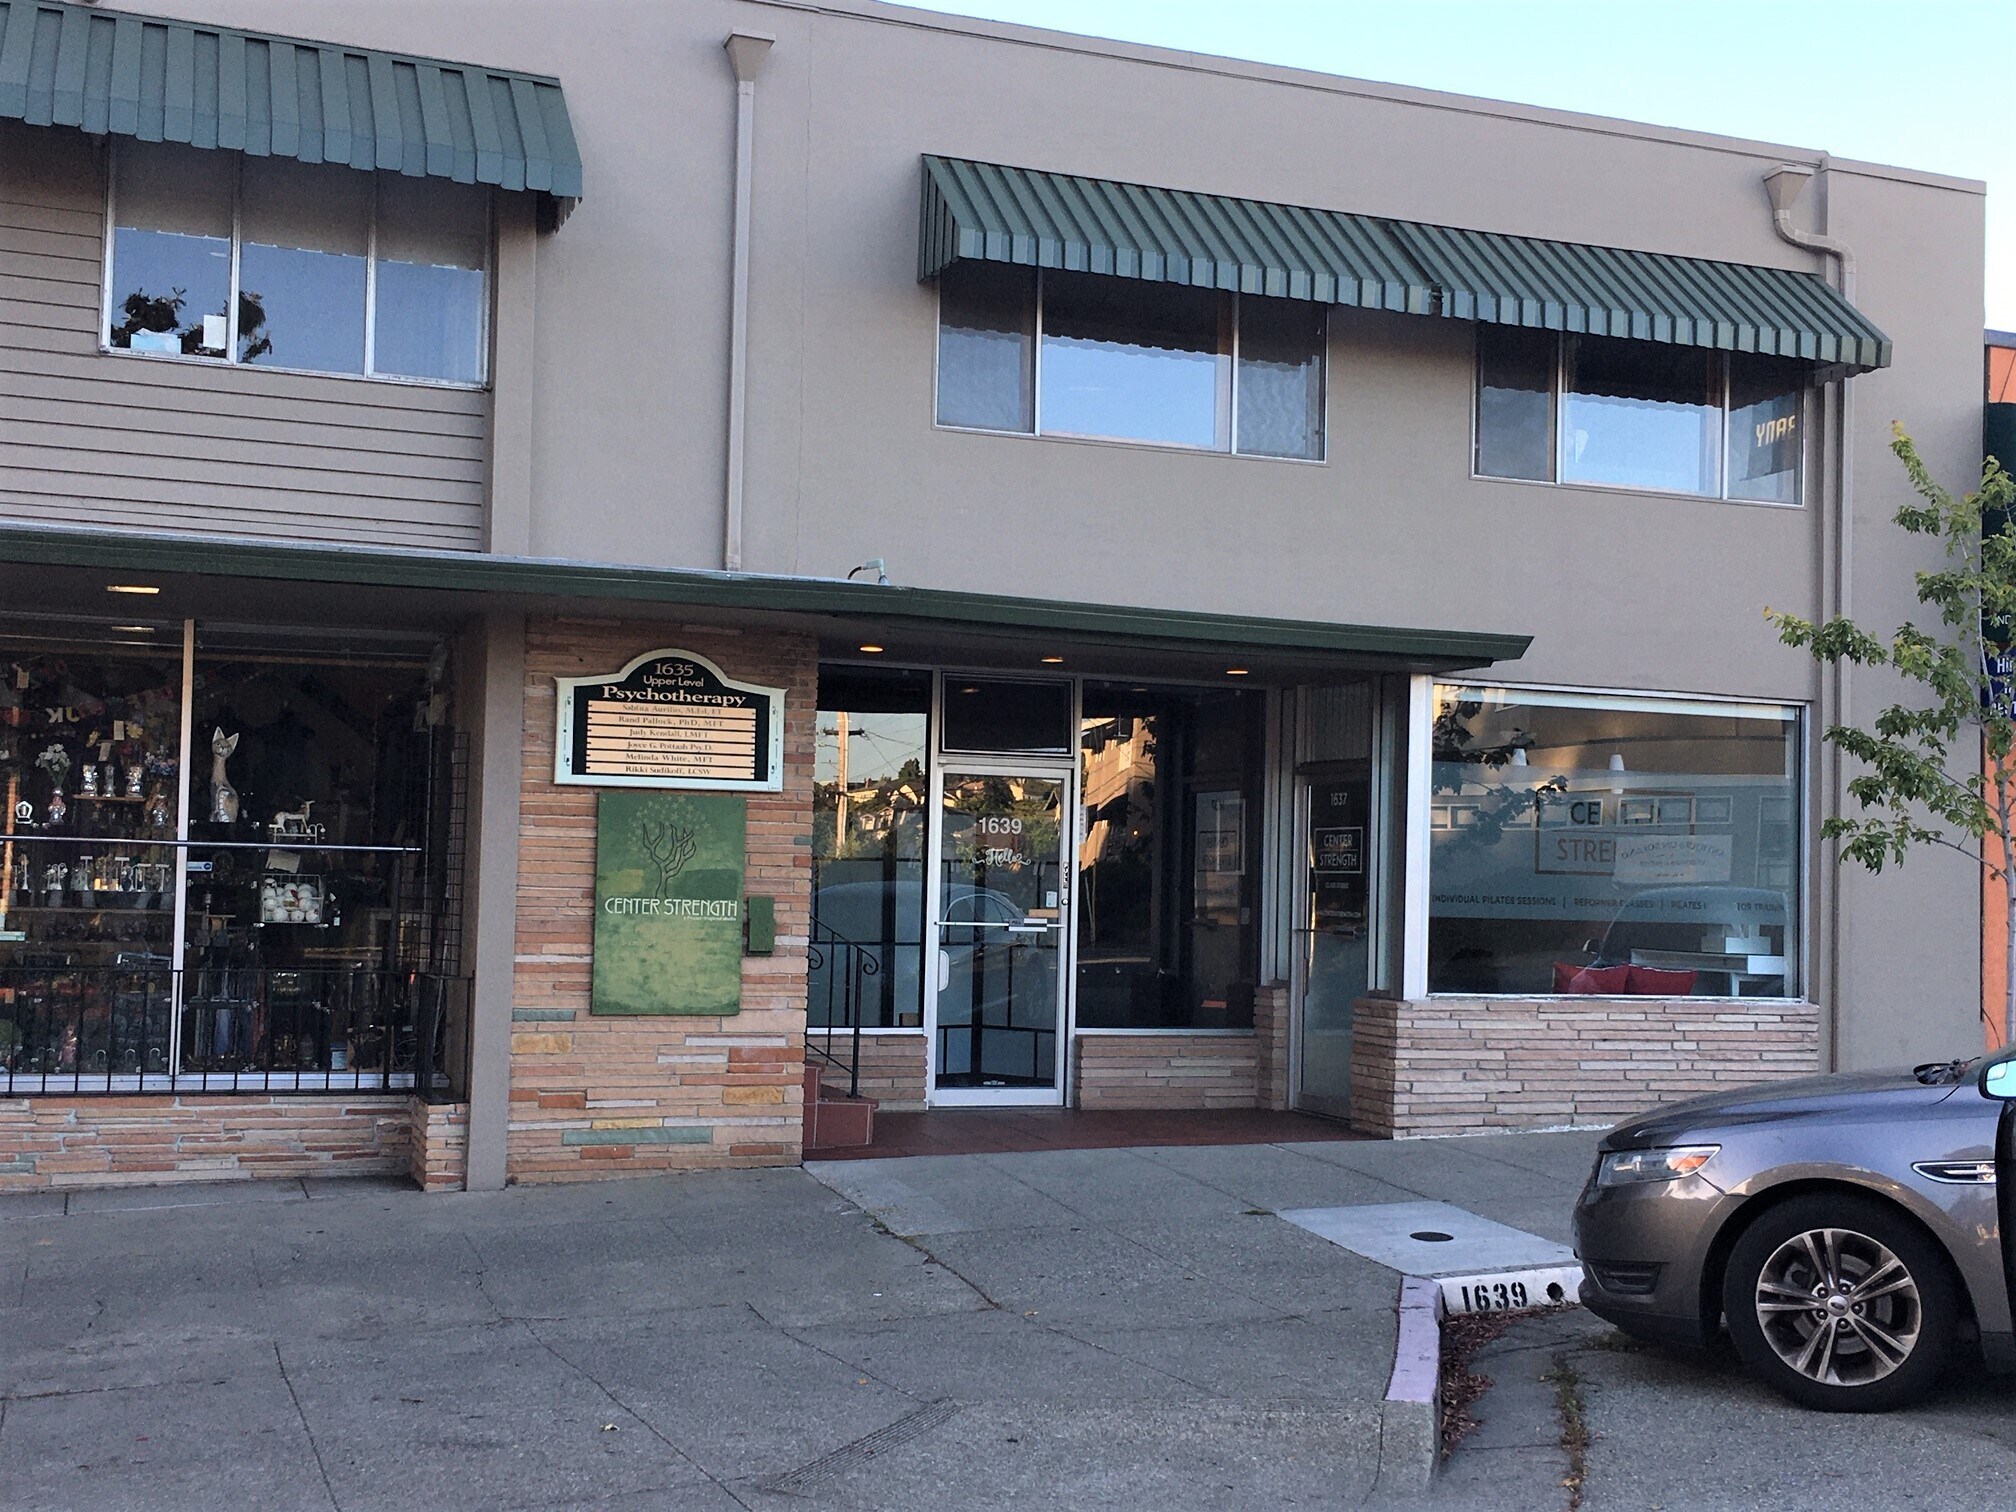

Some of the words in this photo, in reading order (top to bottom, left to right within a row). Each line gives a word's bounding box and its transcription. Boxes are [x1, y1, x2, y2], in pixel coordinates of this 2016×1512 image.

[655, 662, 694, 677] 1635
[643, 675, 677, 687] Upper
[678, 677, 704, 687] Level
[602, 685, 747, 708] Psychotherapy
[1330, 792, 1348, 806] 1637
[979, 817, 1023, 835] 1639
[1323, 834, 1353, 848] CENTER
[984, 847, 1031, 867] Hello
[1319, 853, 1357, 867] STRENGTH
[604, 897, 660, 915] CENTER
[663, 898, 738, 917] STRENGTH
[1482, 896, 1515, 905] PILATES
[1517, 896, 1556, 906] SESSIONS
[1461, 1281, 1528, 1312] 1639
